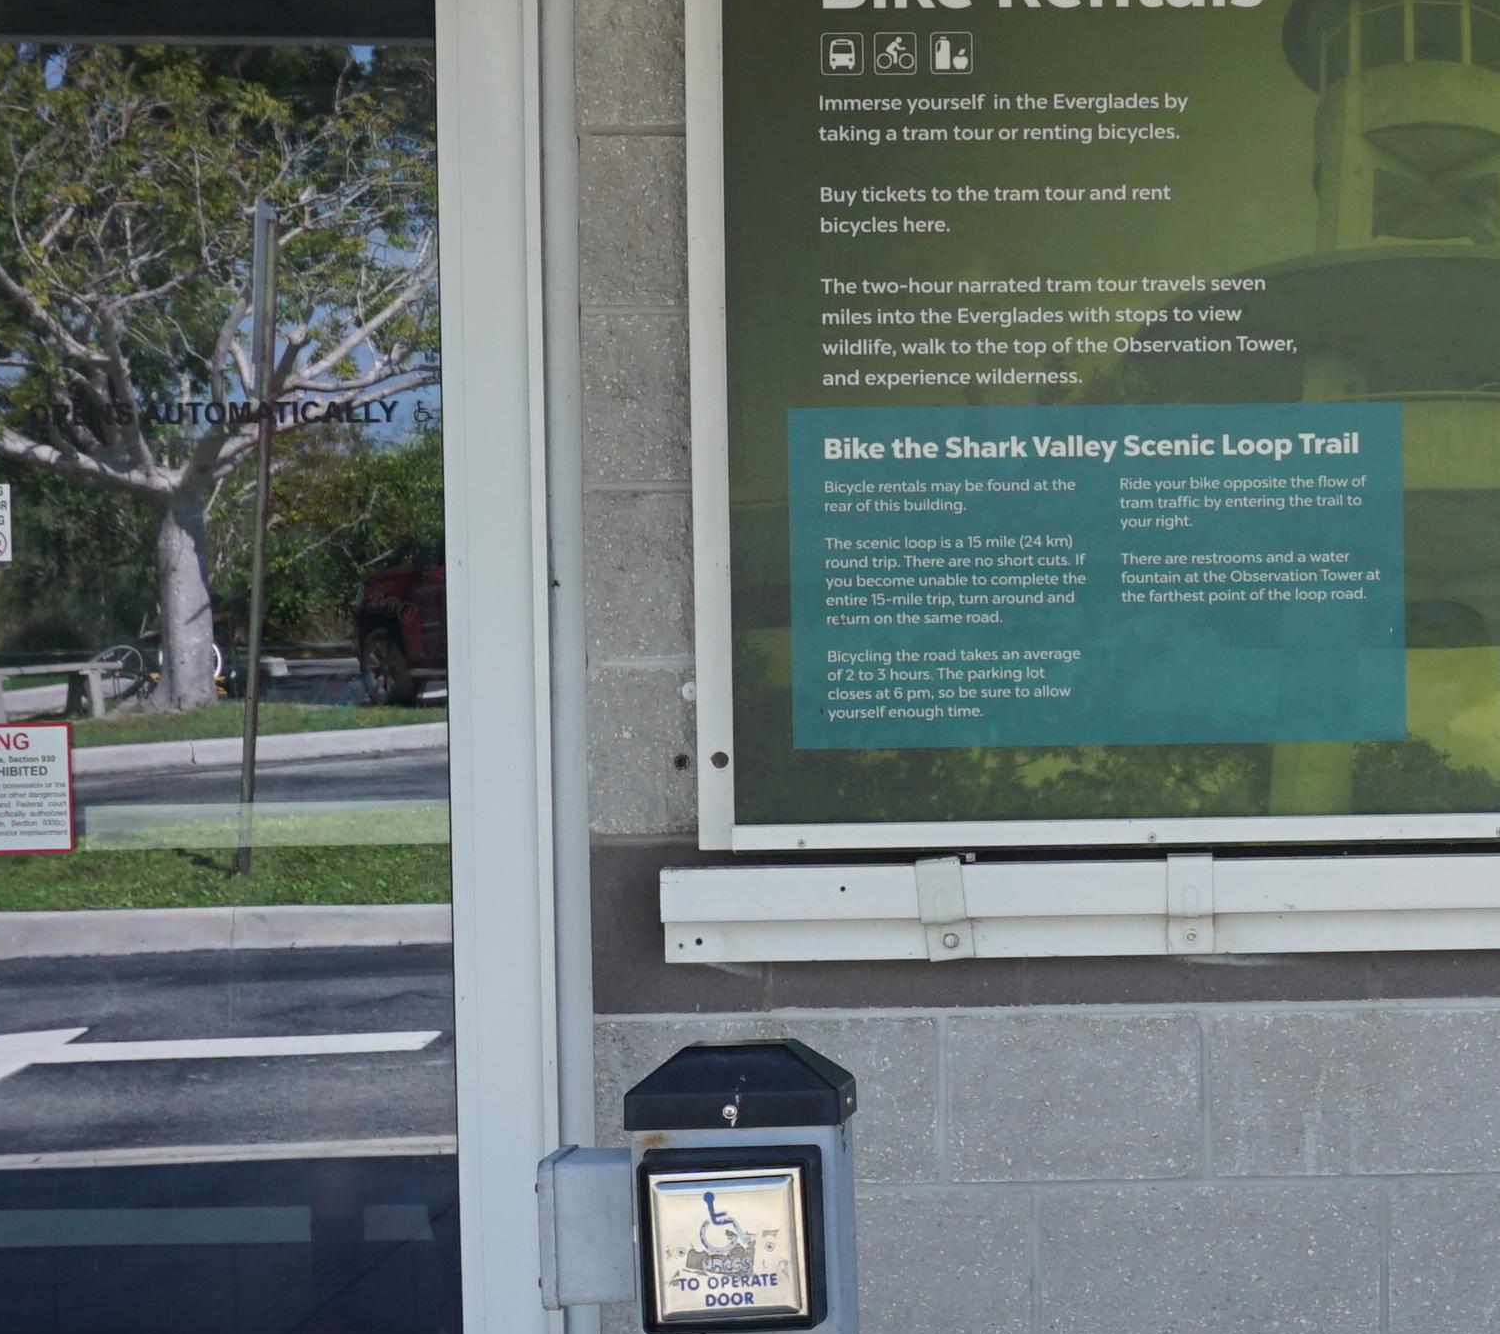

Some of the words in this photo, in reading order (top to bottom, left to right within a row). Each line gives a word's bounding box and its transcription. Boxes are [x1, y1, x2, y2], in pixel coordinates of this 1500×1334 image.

[820, 95, 902, 111] Immerse
[907, 94, 986, 114] yourself
[994, 94, 1010, 109] in
[1016, 94, 1047, 109] the
[1054, 93, 1159, 113] Everglades
[1165, 93, 1188, 112] by
[819, 125, 880, 145] taking
[886, 129, 897, 140] a
[902, 126, 947, 140] tram
[953, 126, 994, 140] tour
[998, 128, 1019, 140] or
[1024, 124, 1092, 144] renting
[1099, 123, 1179, 143] bicycles.
[821, 187, 857, 206] Buy
[862, 186, 926, 202] tickets
[931, 187, 951, 201] to
[957, 186, 989, 201] the
[994, 187, 1039, 201] tram
[1045, 187, 1085, 201] tour
[1090, 185, 1126, 200] and
[1132, 186, 1171, 200] rent
[821, 217, 898, 237] bicycles
[904, 217, 950, 232] here.
[28, 403, 130, 426] OPENS
[144, 399, 397, 425] AUTOMATICALLY
[825, 437, 885, 459] Bike
[891, 437, 939, 458] the
[946, 436, 1027, 458] Shark
[1032, 435, 1117, 462] Valley
[1124, 434, 1215, 456] Scenic
[1223, 434, 1292, 461] Loop
[1298, 432, 1358, 454] Trail
[678, 1278, 700, 1291] TO
[708, 1273, 778, 1289] OPERATE
[706, 1292, 754, 1306] DOOR
